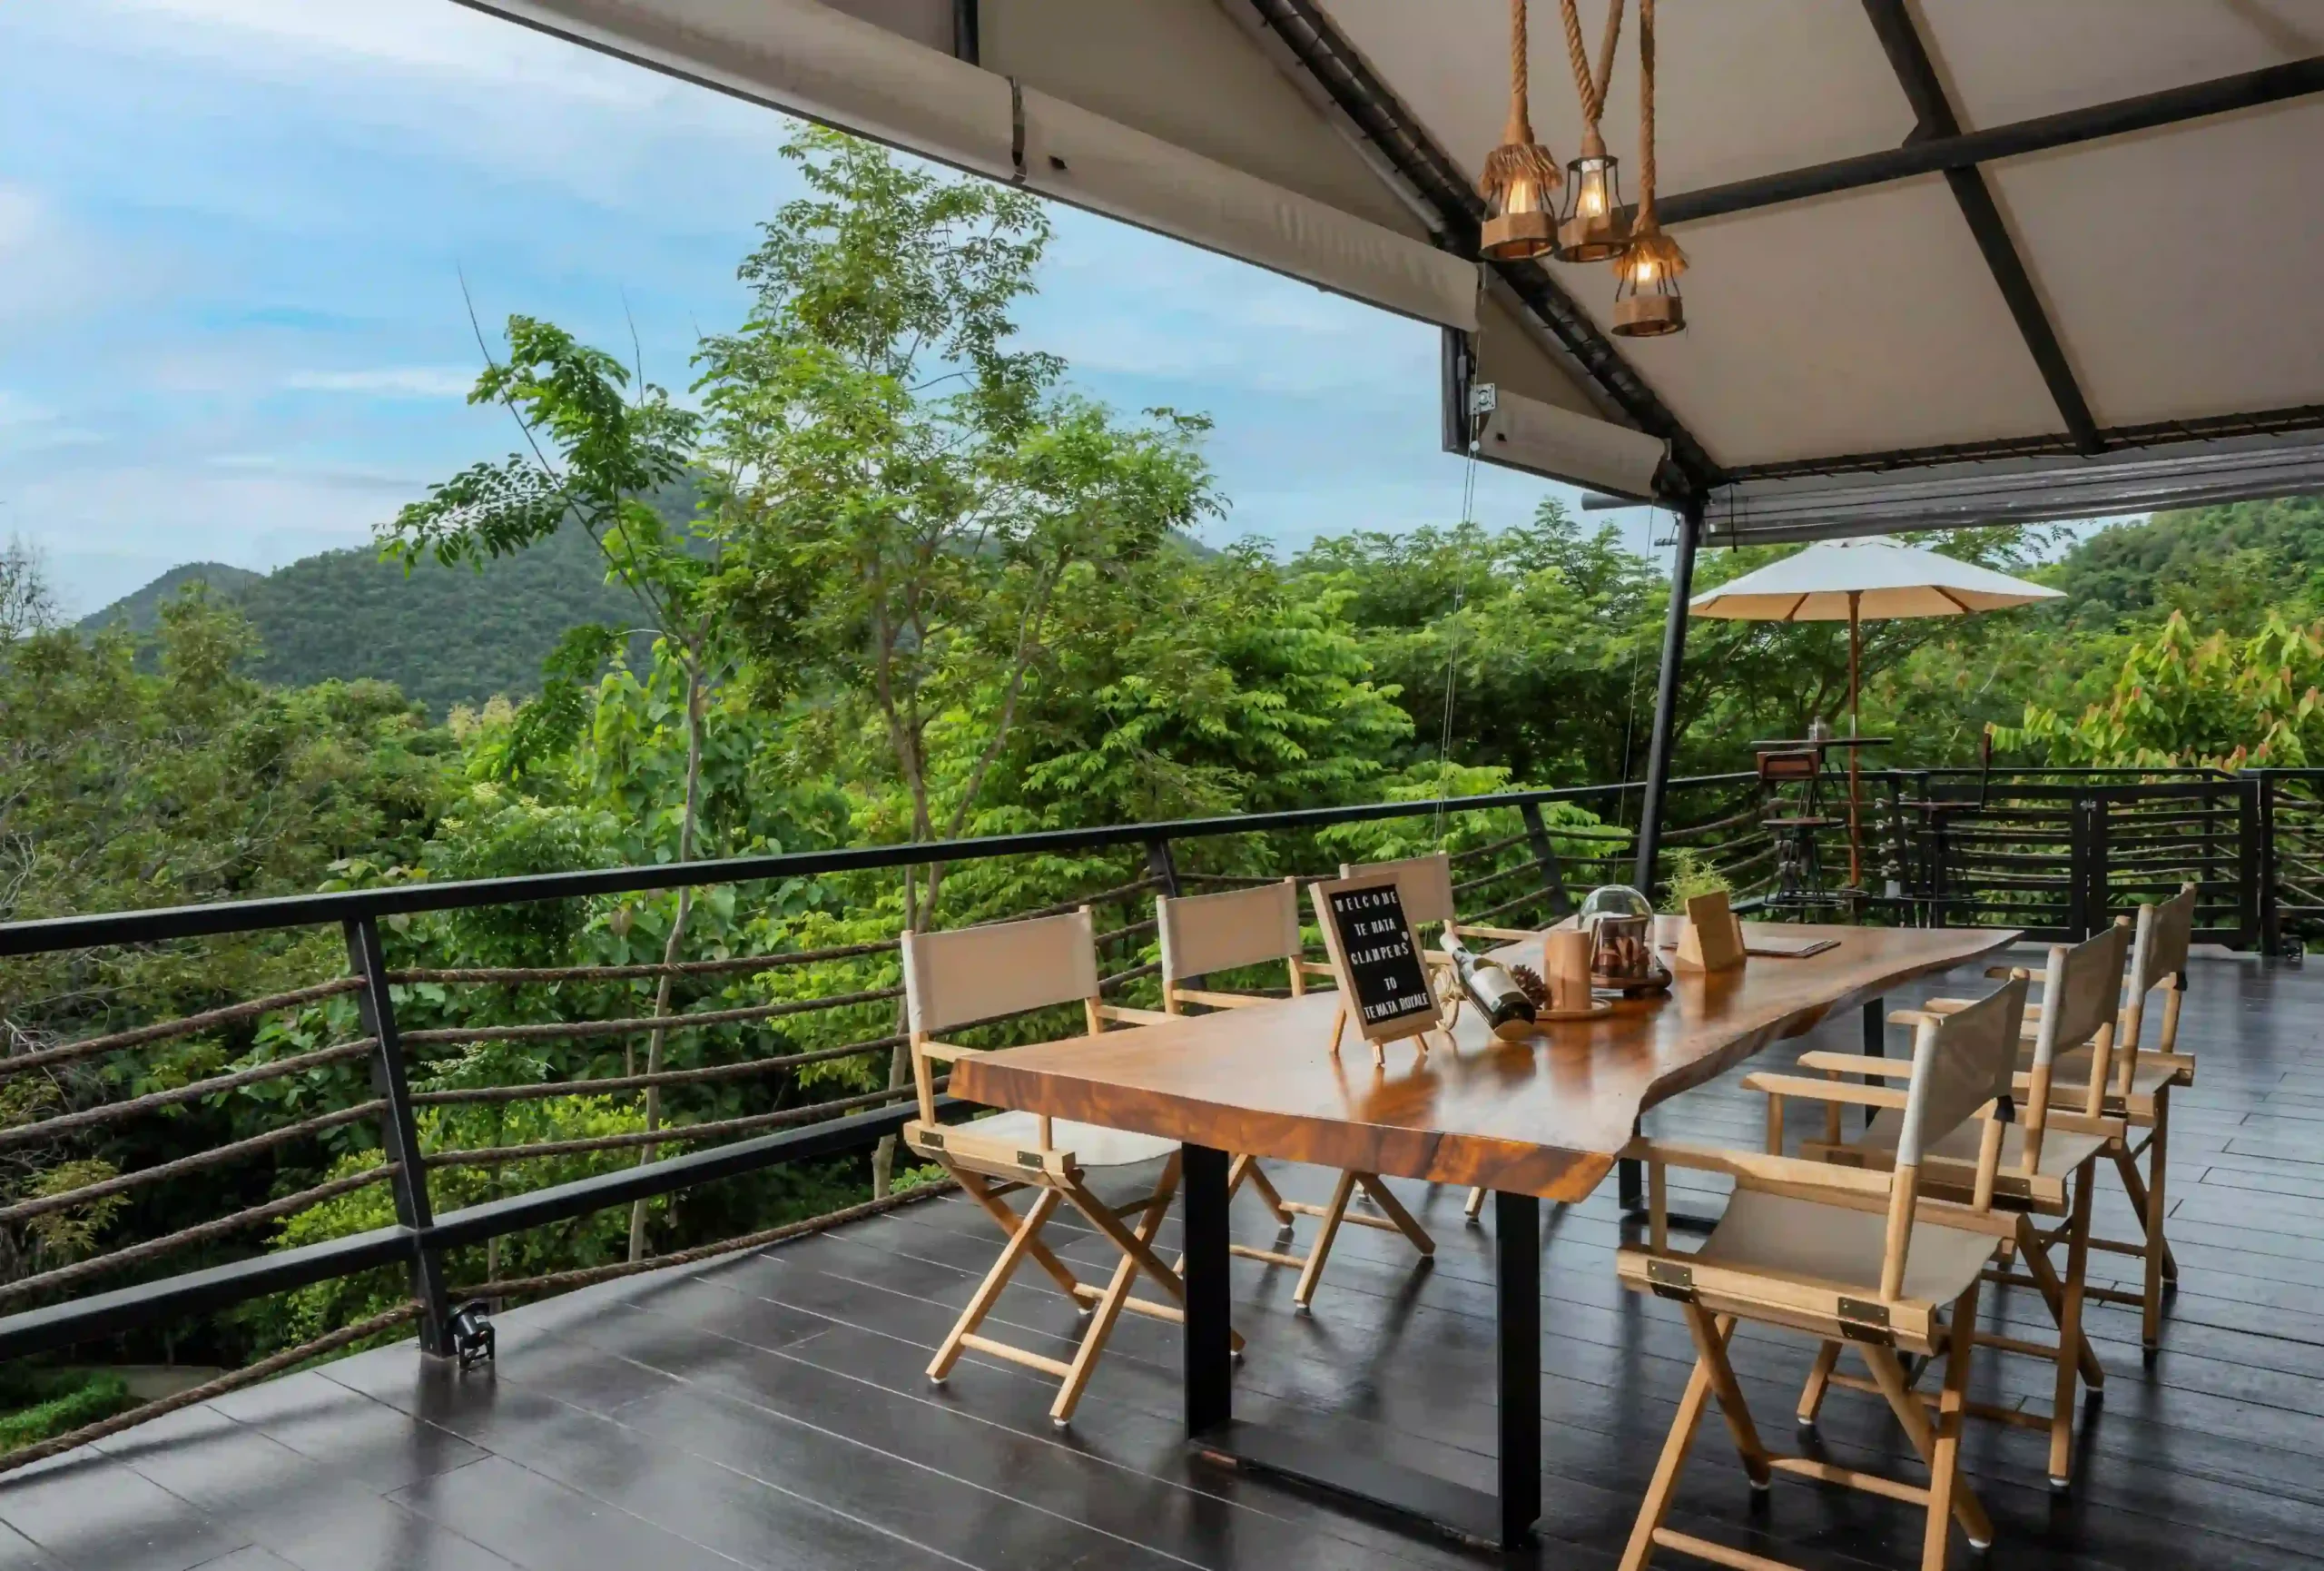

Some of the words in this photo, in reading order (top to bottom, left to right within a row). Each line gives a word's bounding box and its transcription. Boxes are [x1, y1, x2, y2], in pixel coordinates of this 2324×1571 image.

[1334, 891, 1398, 912] WELCOME
[1354, 923, 1368, 936] TE
[1371, 917, 1396, 934] MATA
[1351, 942, 1409, 965] GLAMPERS
[1384, 976, 1397, 991] TO
[1364, 1005, 1375, 1019] TE
[1375, 1001, 1398, 1017] MATA
[1399, 993, 1429, 1011] ROYALE
